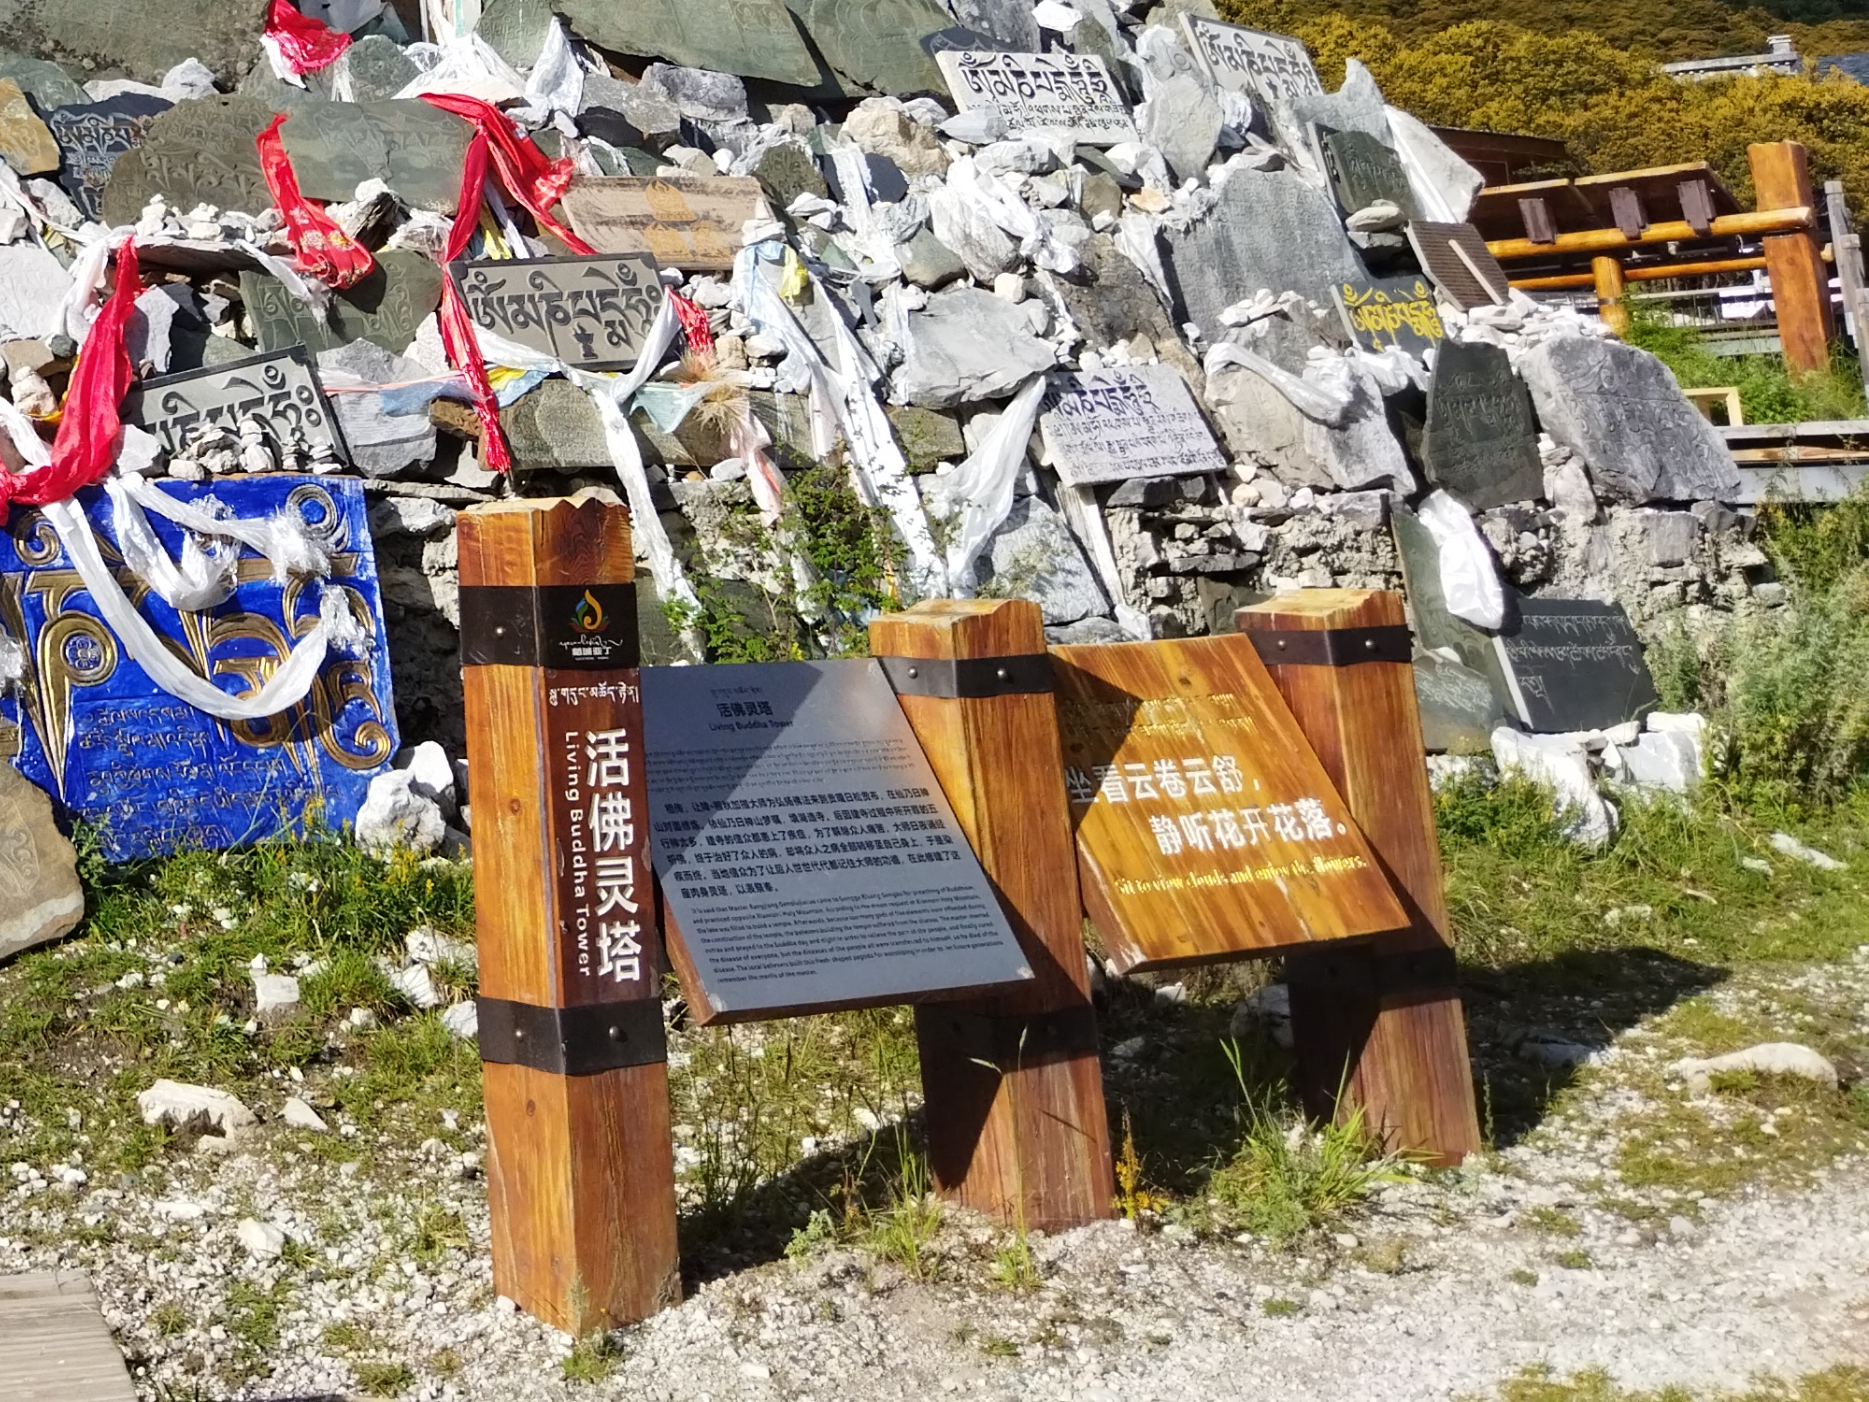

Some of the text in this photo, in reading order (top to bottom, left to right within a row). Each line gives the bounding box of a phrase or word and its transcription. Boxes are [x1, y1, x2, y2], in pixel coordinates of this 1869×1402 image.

[708, 718, 794, 732] Living Buddha Tower
[716, 701, 773, 718] 活佛灵塔
[1148, 796, 1347, 855] 静听花开花落。
[565, 731, 591, 976] Living Buddha Tower
[584, 728, 642, 982] 活佛灵塔
[1115, 877, 1135, 895] Sit
[1137, 879, 1150, 893] to
[1153, 874, 1184, 893] view
[1187, 869, 1228, 888] clouds
[1230, 865, 1254, 883] and
